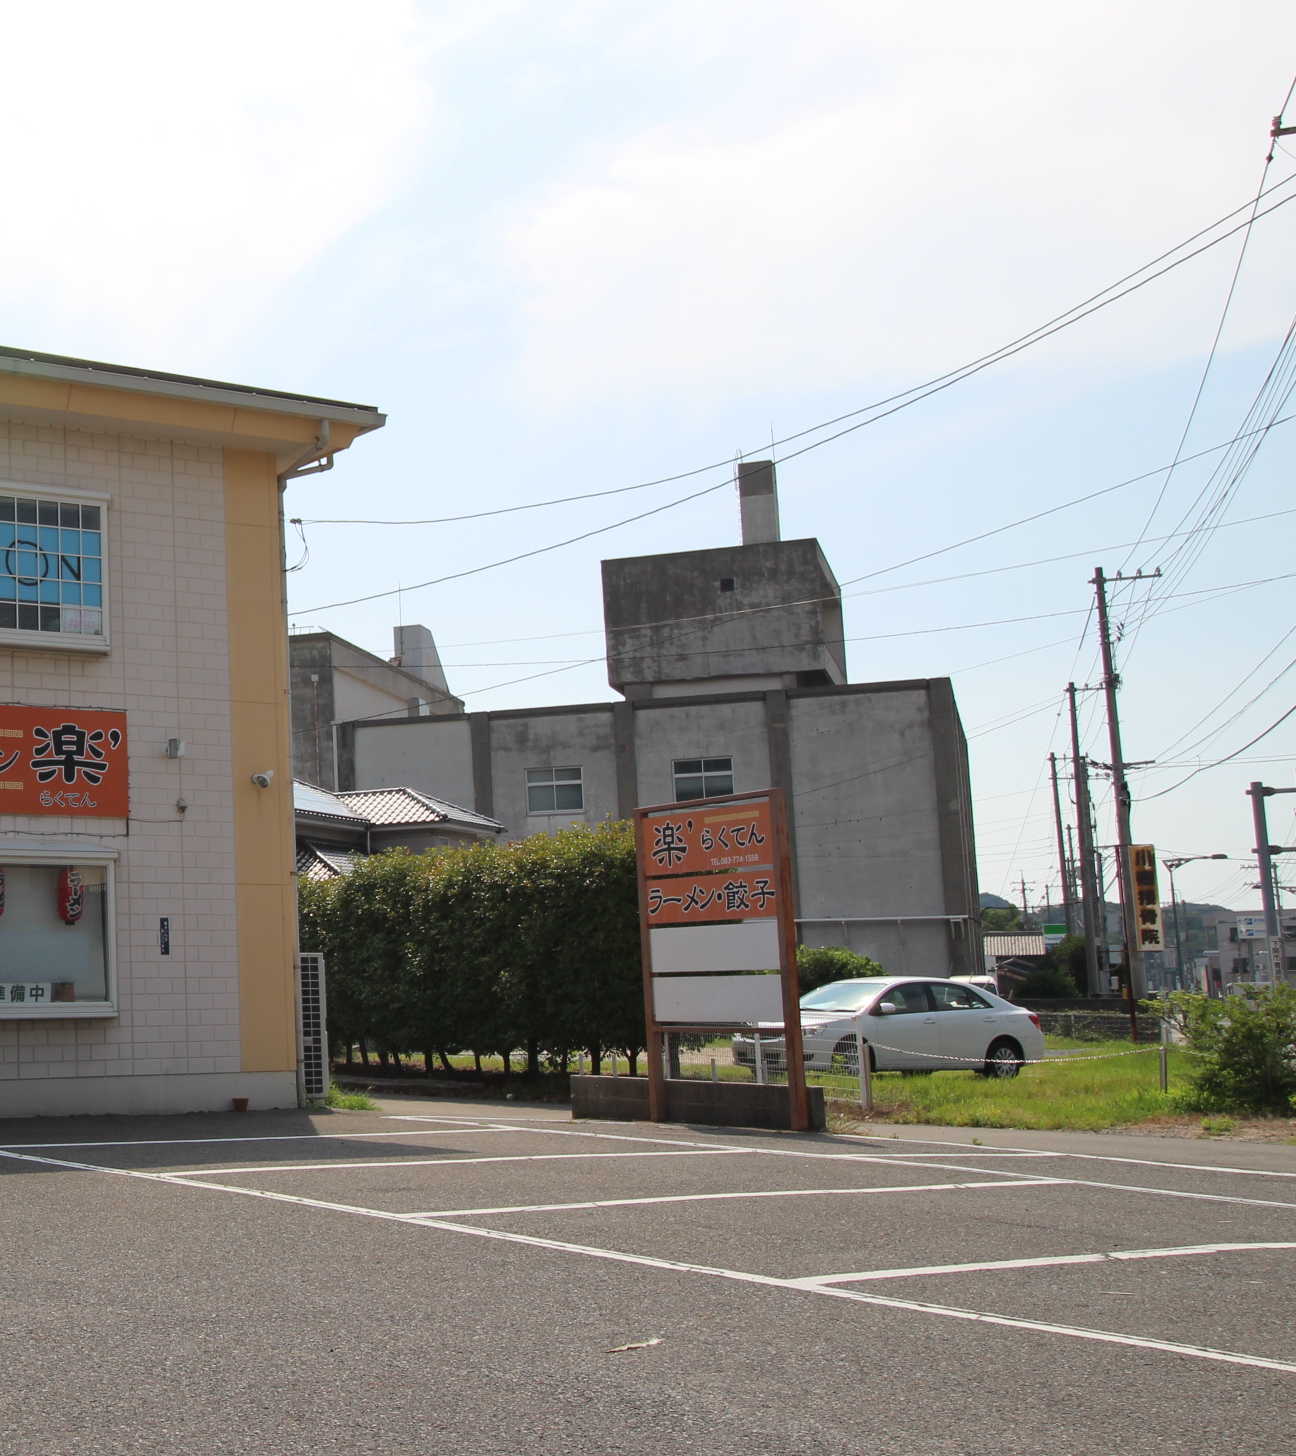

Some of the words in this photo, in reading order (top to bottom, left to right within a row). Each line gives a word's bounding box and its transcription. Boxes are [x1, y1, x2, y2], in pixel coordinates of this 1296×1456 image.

[38, 790, 97, 808] らくてん
[700, 822, 766, 852] らくてん
[710, 858, 721, 866] TEL
[67, 871, 83, 919] ラーメン
[648, 878, 776, 915] ラーメン・餃子
